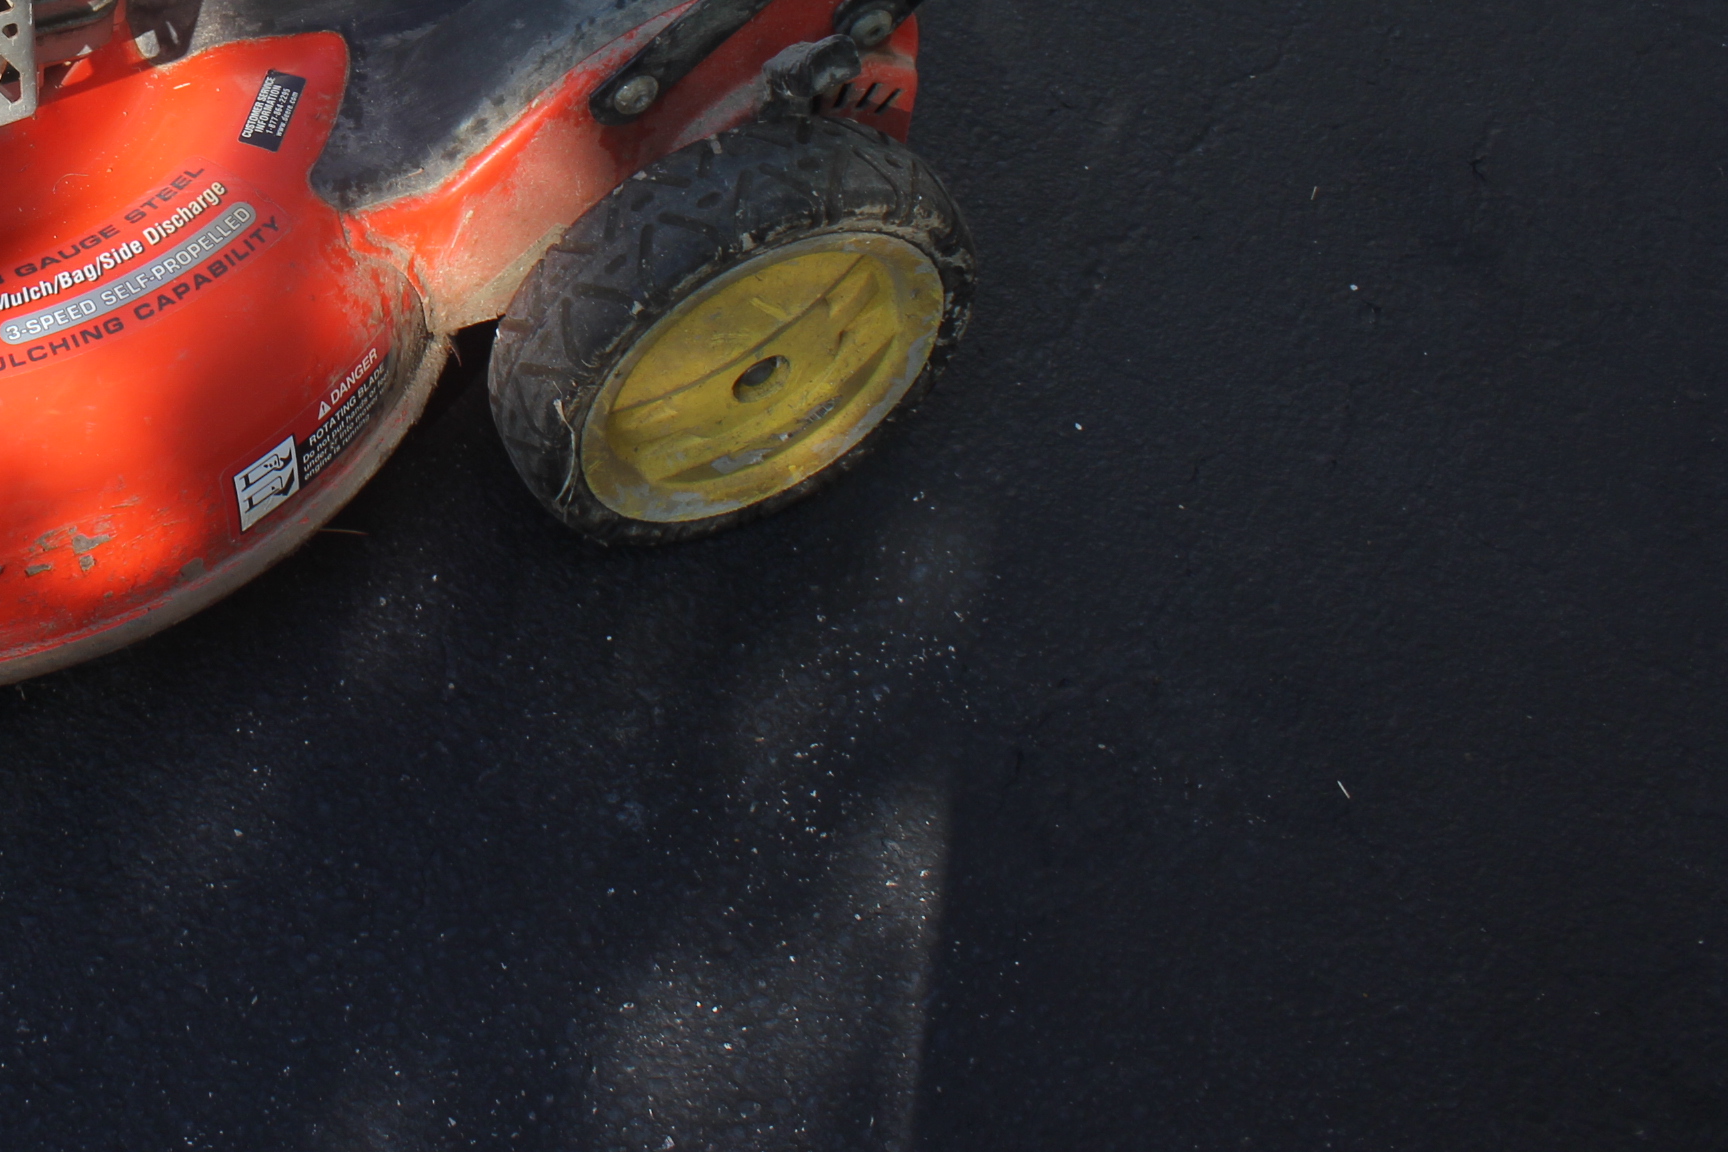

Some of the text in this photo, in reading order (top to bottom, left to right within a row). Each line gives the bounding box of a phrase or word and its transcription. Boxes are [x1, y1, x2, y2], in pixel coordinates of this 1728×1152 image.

[241, 76, 275, 138] CUSTOMER SERVICE
[253, 84, 281, 133] INFORMATION
[265, 88, 291, 134] 1-877-864-2295
[274, 92, 299, 136] www.deere.com
[14, 224, 120, 276] GAUGE
[124, 167, 205, 224] STEEL
[142, 180, 227, 246] Discharge
[4, 206, 252, 341] 3-SPEED SELF-PROPELLED
[133, 216, 280, 321] CAPABILITY
[307, 362, 384, 446] ROTATING BLADE
[330, 346, 379, 405] DANGER
[302, 449, 315, 463] Do
[315, 434, 331, 452] not
[331, 421, 345, 440] put
[344, 395, 367, 423] hands
[303, 447, 328, 472] under
[339, 420, 354, 440] into
[304, 452, 332, 481] engine
[341, 412, 370, 446] running
